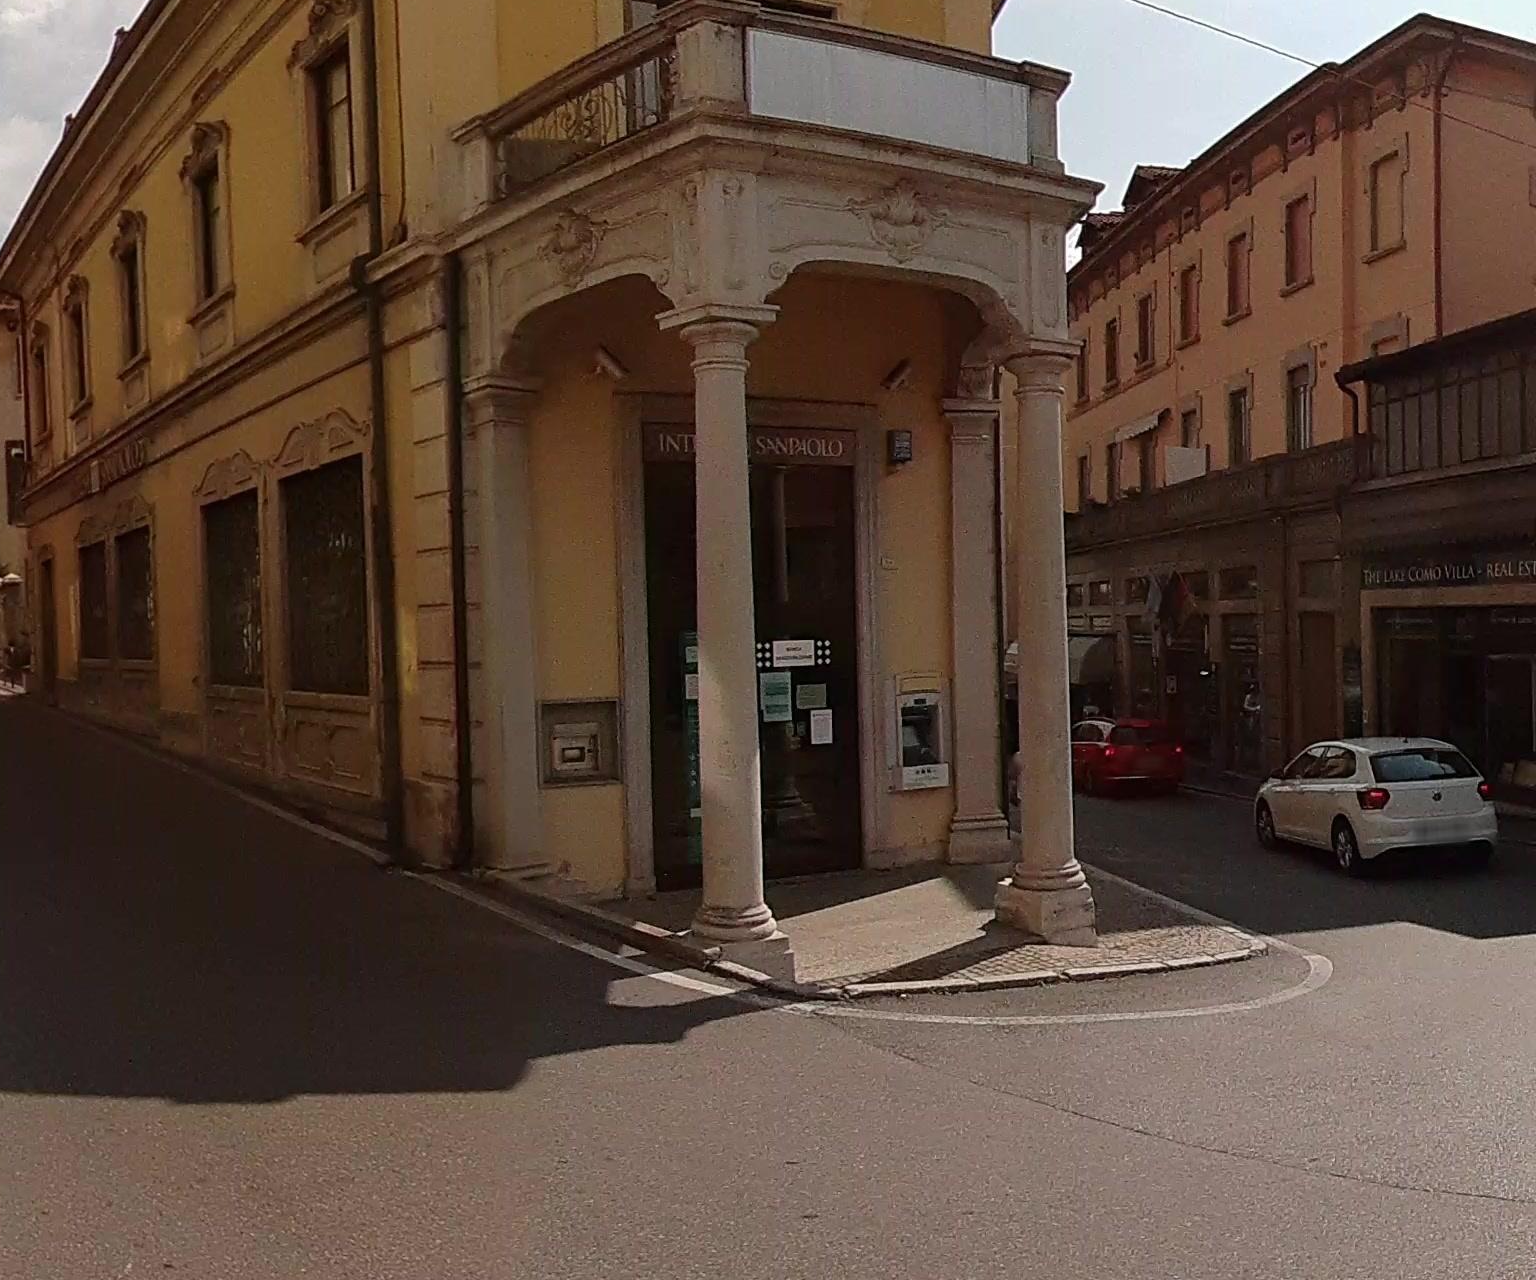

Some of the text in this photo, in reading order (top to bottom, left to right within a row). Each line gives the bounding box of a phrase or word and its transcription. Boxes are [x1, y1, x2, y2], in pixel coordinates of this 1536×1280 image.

[756, 436, 843, 458] SANPAOLO
[1363, 569, 1381, 585] THE
[1384, 569, 1405, 583] LAKE
[1408, 566, 1442, 582] COMO
[1445, 563, 1475, 580] VILLA
[1486, 561, 1515, 577] REAL
